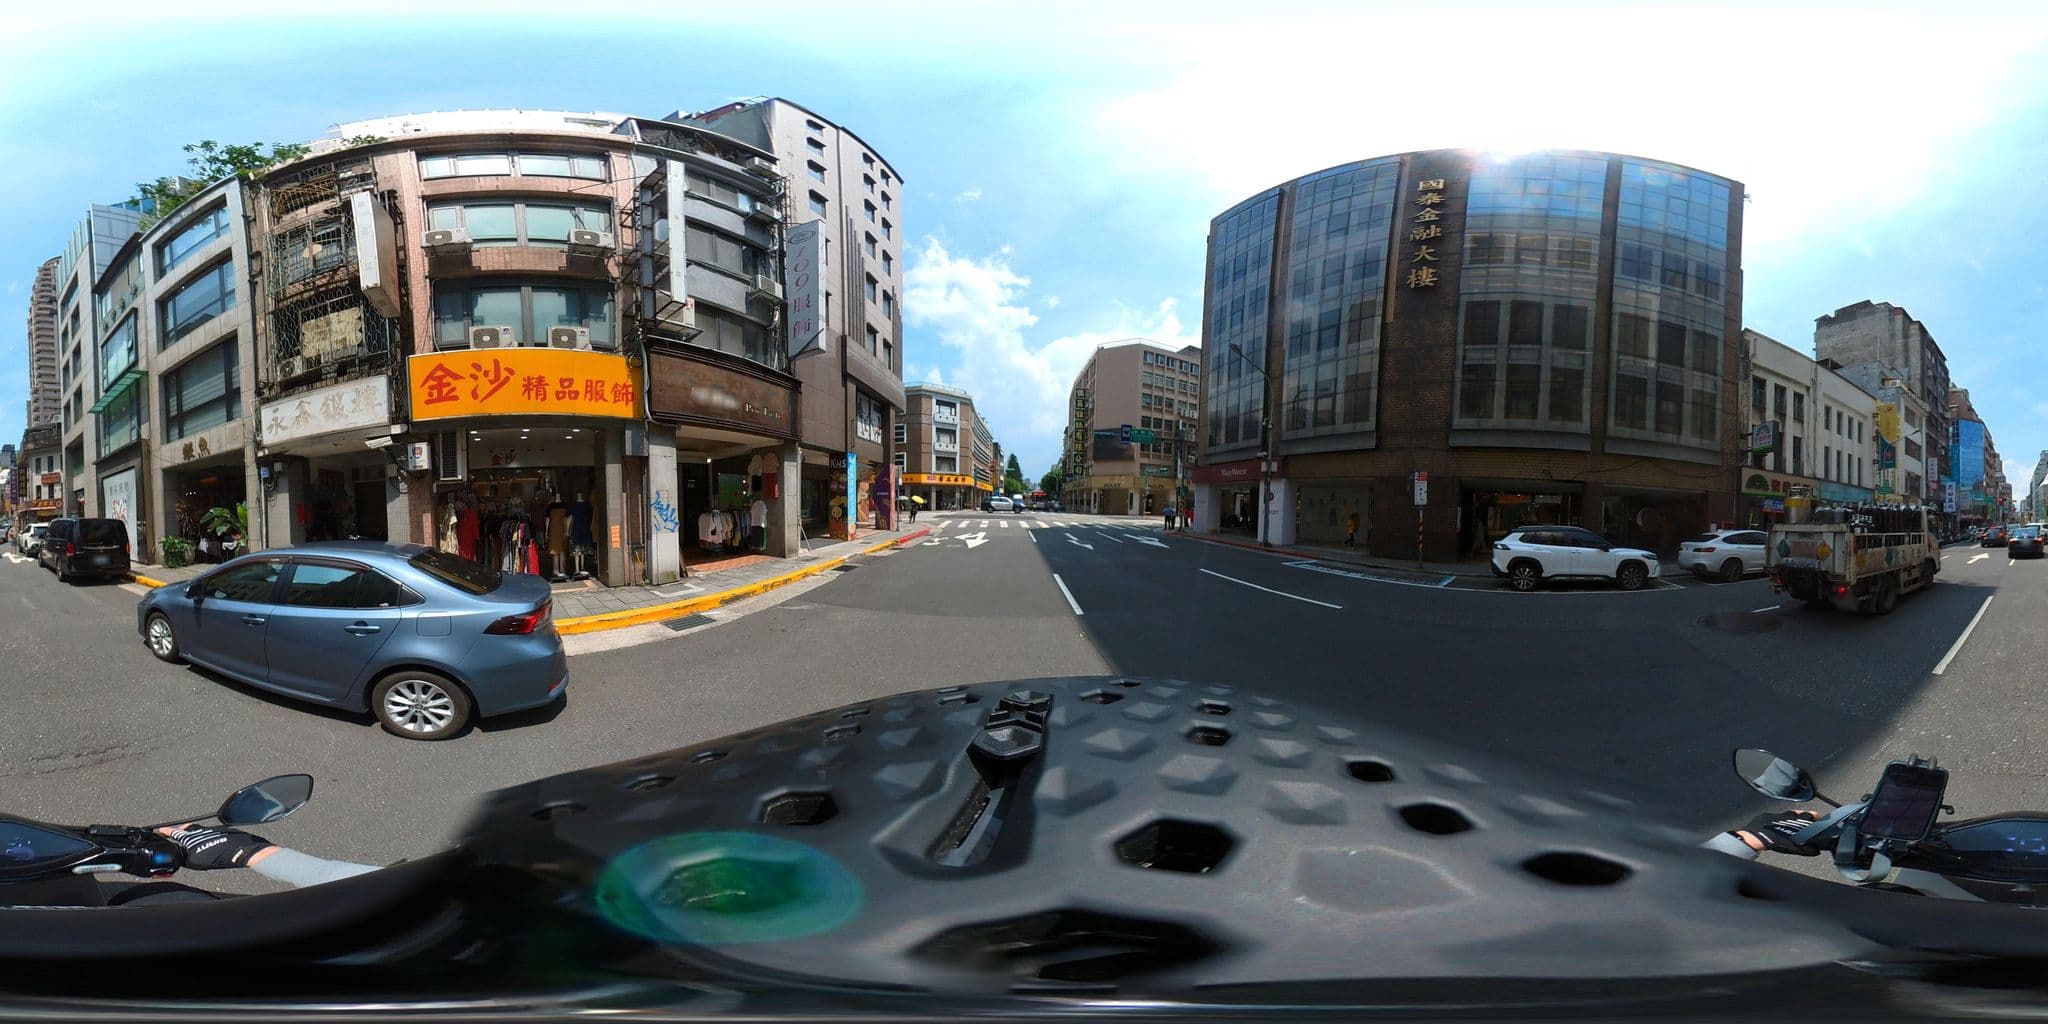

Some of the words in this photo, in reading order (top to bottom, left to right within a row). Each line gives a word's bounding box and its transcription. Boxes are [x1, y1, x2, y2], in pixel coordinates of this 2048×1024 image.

[1406, 178, 1446, 289] 國泰金融大樓
[420, 358, 516, 406] 金沙
[521, 374, 635, 407] 精品服飾
[831, 457, 846, 468] KHS
[195, 837, 228, 853] GIANT
